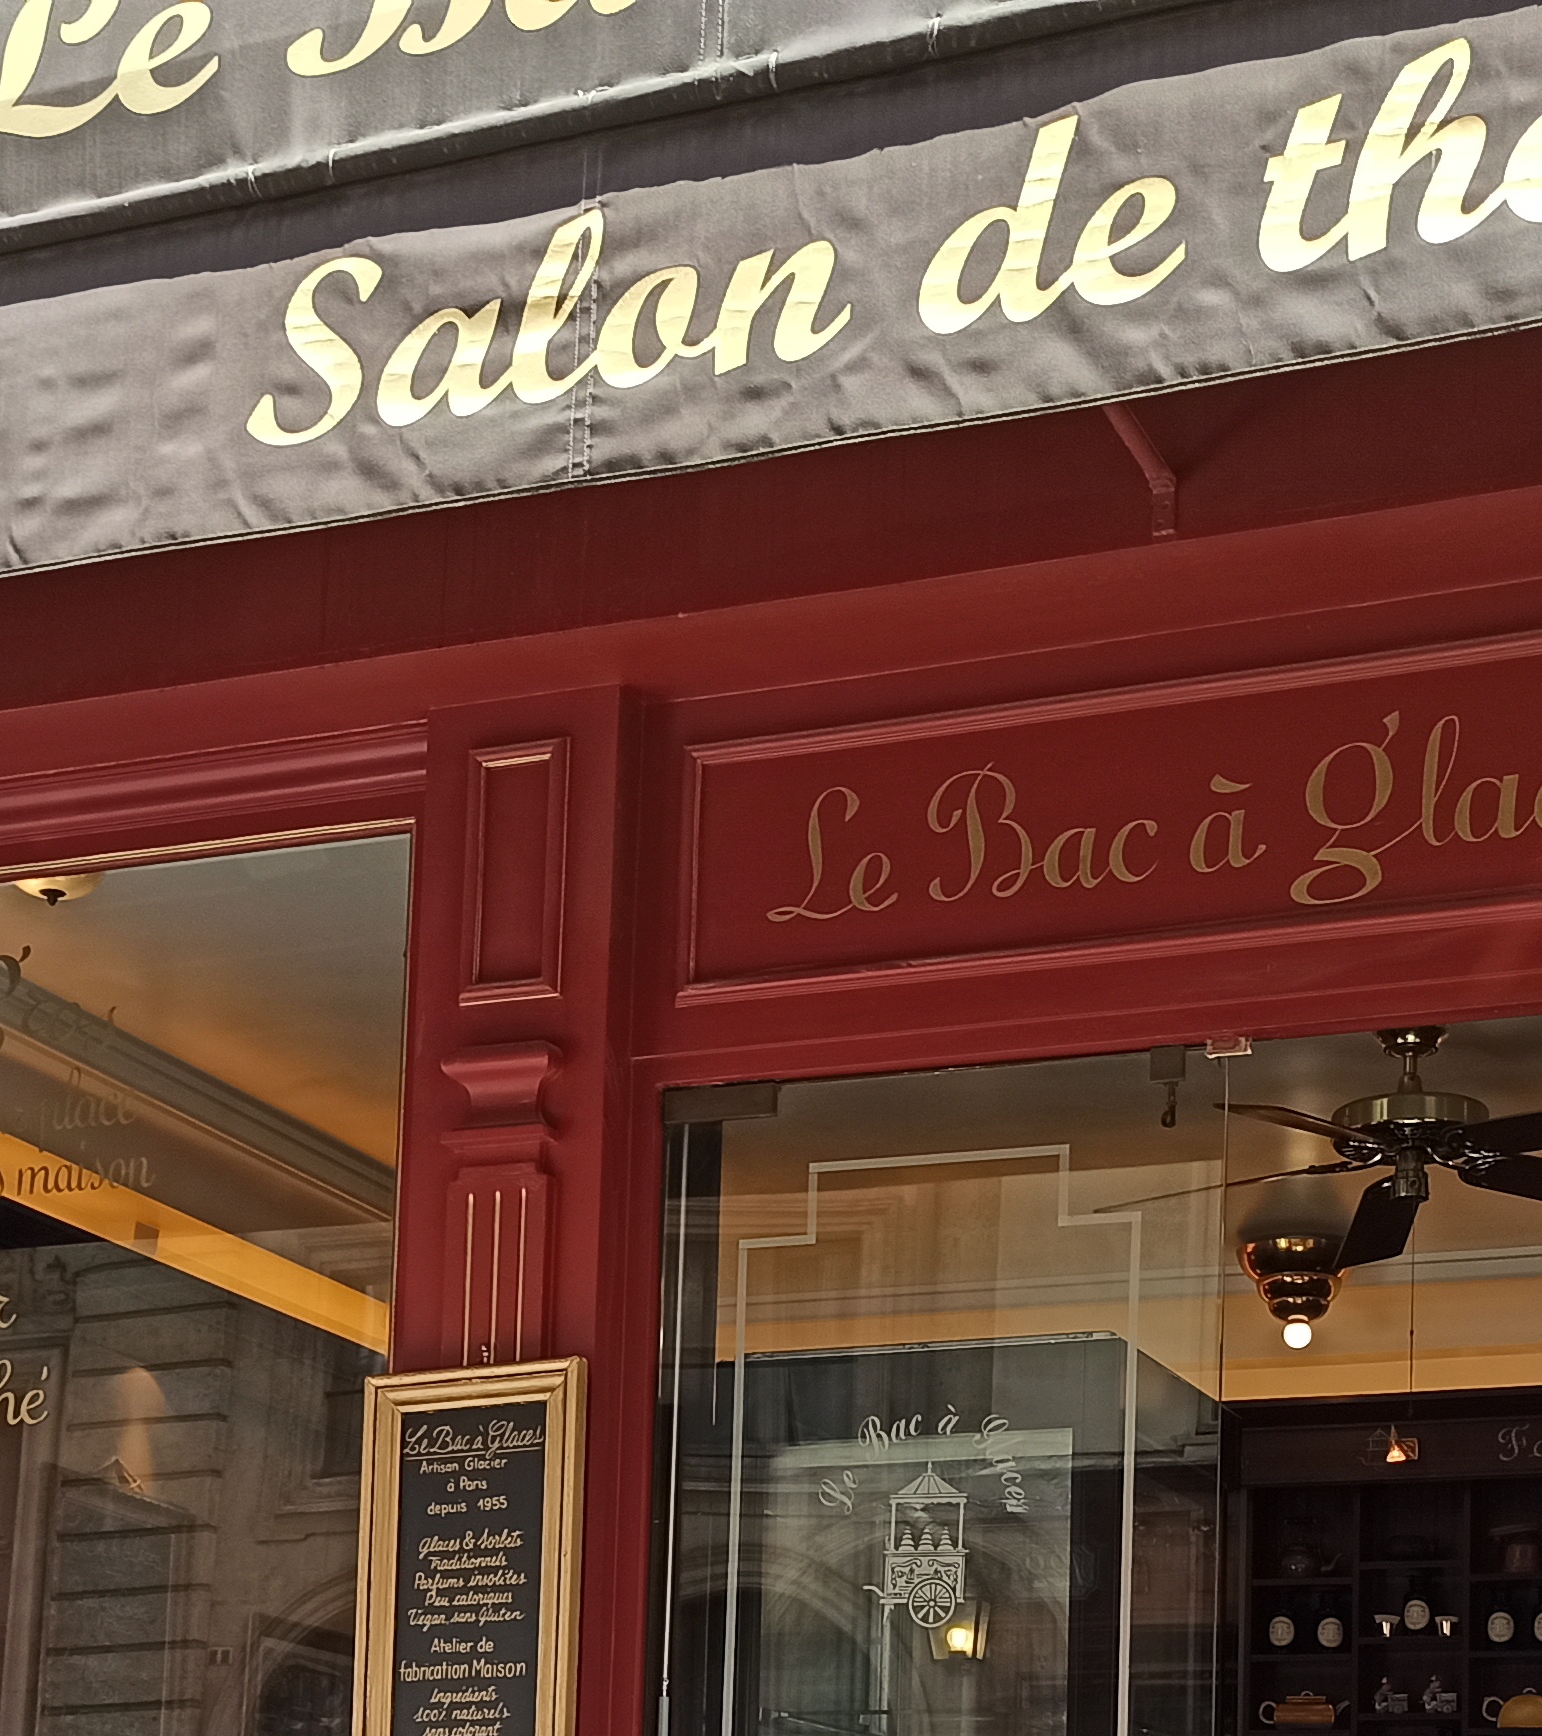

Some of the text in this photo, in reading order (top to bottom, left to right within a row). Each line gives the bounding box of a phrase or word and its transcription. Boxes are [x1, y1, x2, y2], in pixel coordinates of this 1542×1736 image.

[245, 208, 852, 447] Salon
[918, 114, 1186, 335] de
[765, 786, 898, 923] Le
[927, 762, 1159, 903] Bac
[1188, 773, 1267, 873] à
[403, 1425, 429, 1454] Le
[429, 1425, 471, 1453] Bac
[472, 1425, 484, 1449] à
[420, 1457, 508, 1474] Artisan Glacier
[818, 1469, 859, 1515] Le
[859, 1413, 923, 1460] Bac
[937, 1404, 960, 1436] à
[447, 1476, 488, 1492] à Paris
[427, 1495, 508, 1517] depuis 1955
[462, 1530, 476, 1549] &
[427, 1551, 508, 1570] Traditionnels
[414, 1569, 527, 1593] Parfums insolites
[450, 1611, 476, 1623] sans
[430, 1635, 494, 1653] Atelier de
[398, 1658, 526, 1681] fabrication Maison
[413, 1701, 511, 1722] 100% naturels
